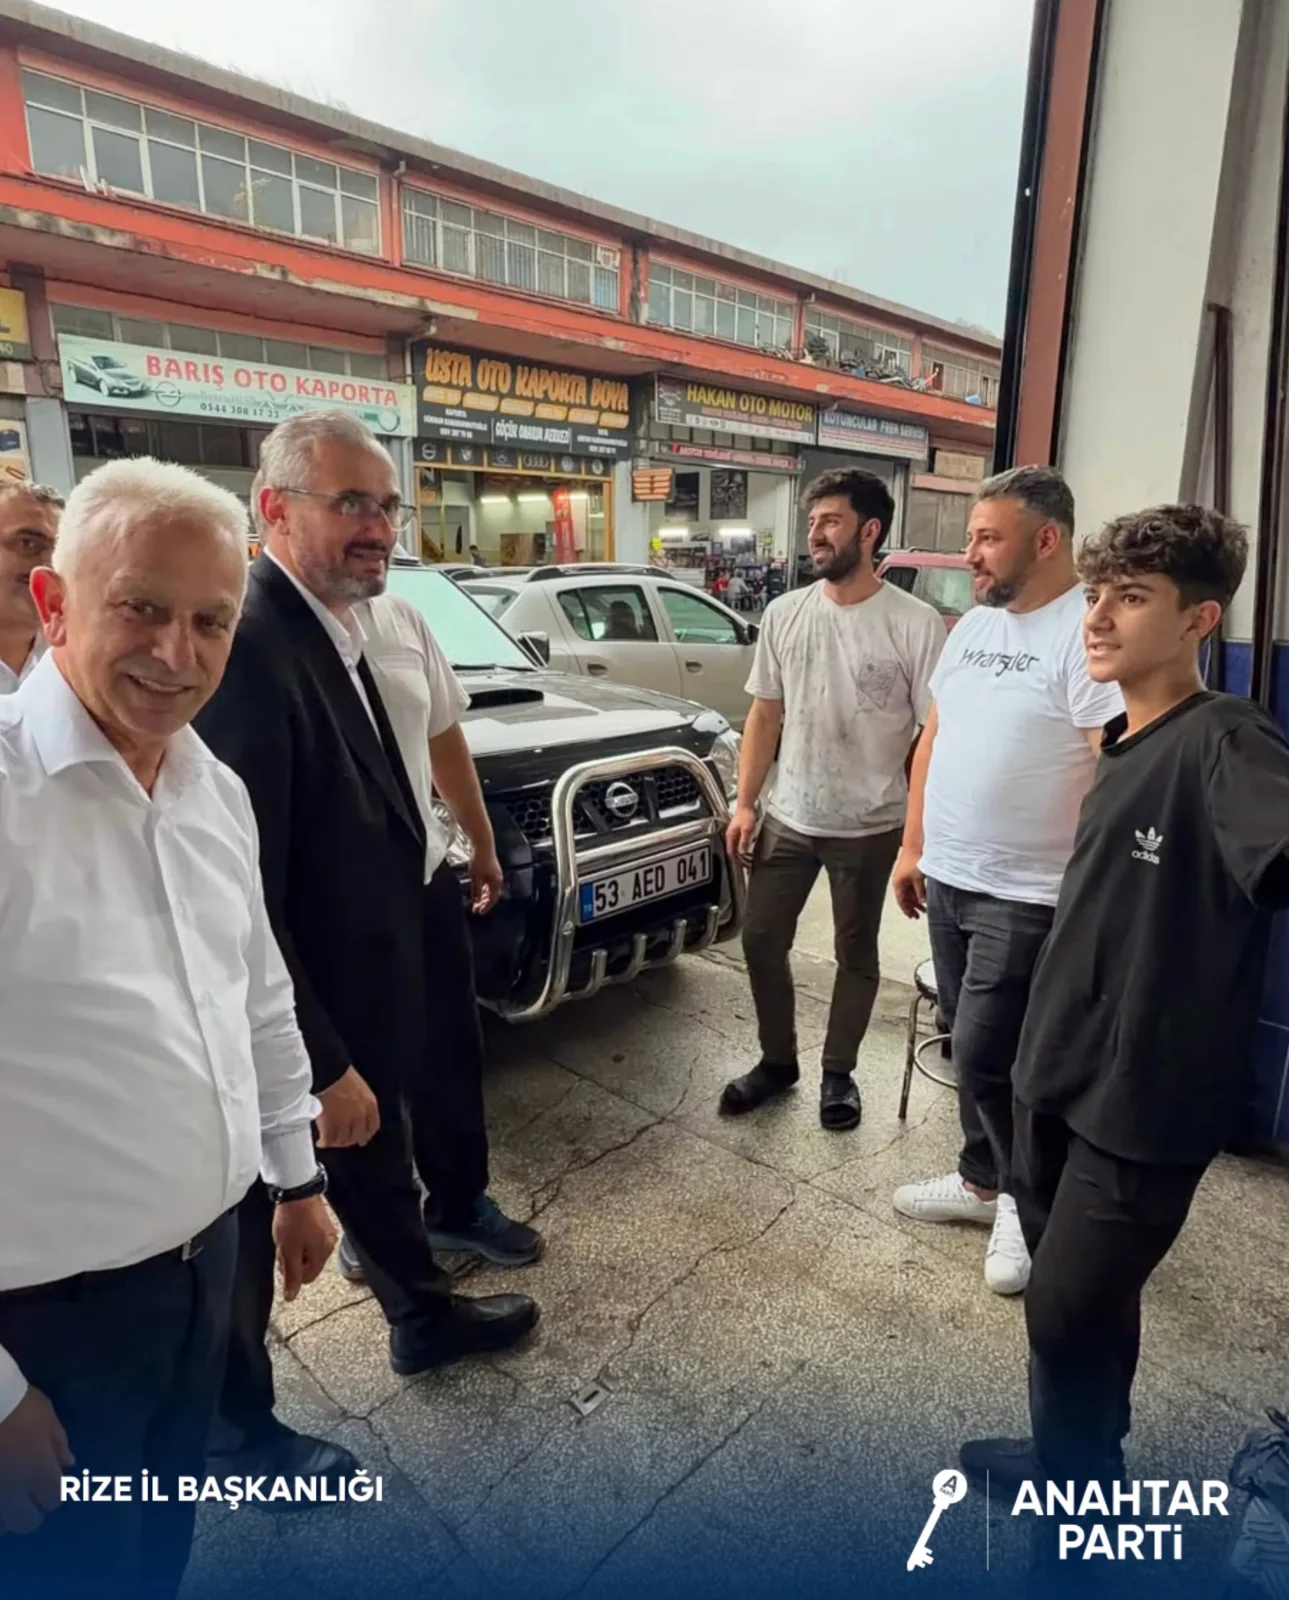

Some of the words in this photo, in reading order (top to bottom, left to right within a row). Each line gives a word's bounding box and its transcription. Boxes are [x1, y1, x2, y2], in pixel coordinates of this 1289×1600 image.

[146, 355, 224, 391] BARIŞ
[234, 368, 287, 393] OTO
[296, 375, 398, 407] KAPORTA
[425, 347, 473, 388] USTA
[477, 358, 511, 394] OTO
[515, 364, 587, 405] KAPORTA
[590, 377, 630, 411] BOYA
[685, 383, 736, 409] HAKAN
[739, 394, 766, 414] OTO
[768, 400, 814, 423] MOTOR
[958, 648, 1041, 677] Wrangler
[1131, 850, 1160, 865] adidas
[594, 880, 619, 912] 53
[632, 864, 666, 901] AED
[676, 851, 707, 885] 041
